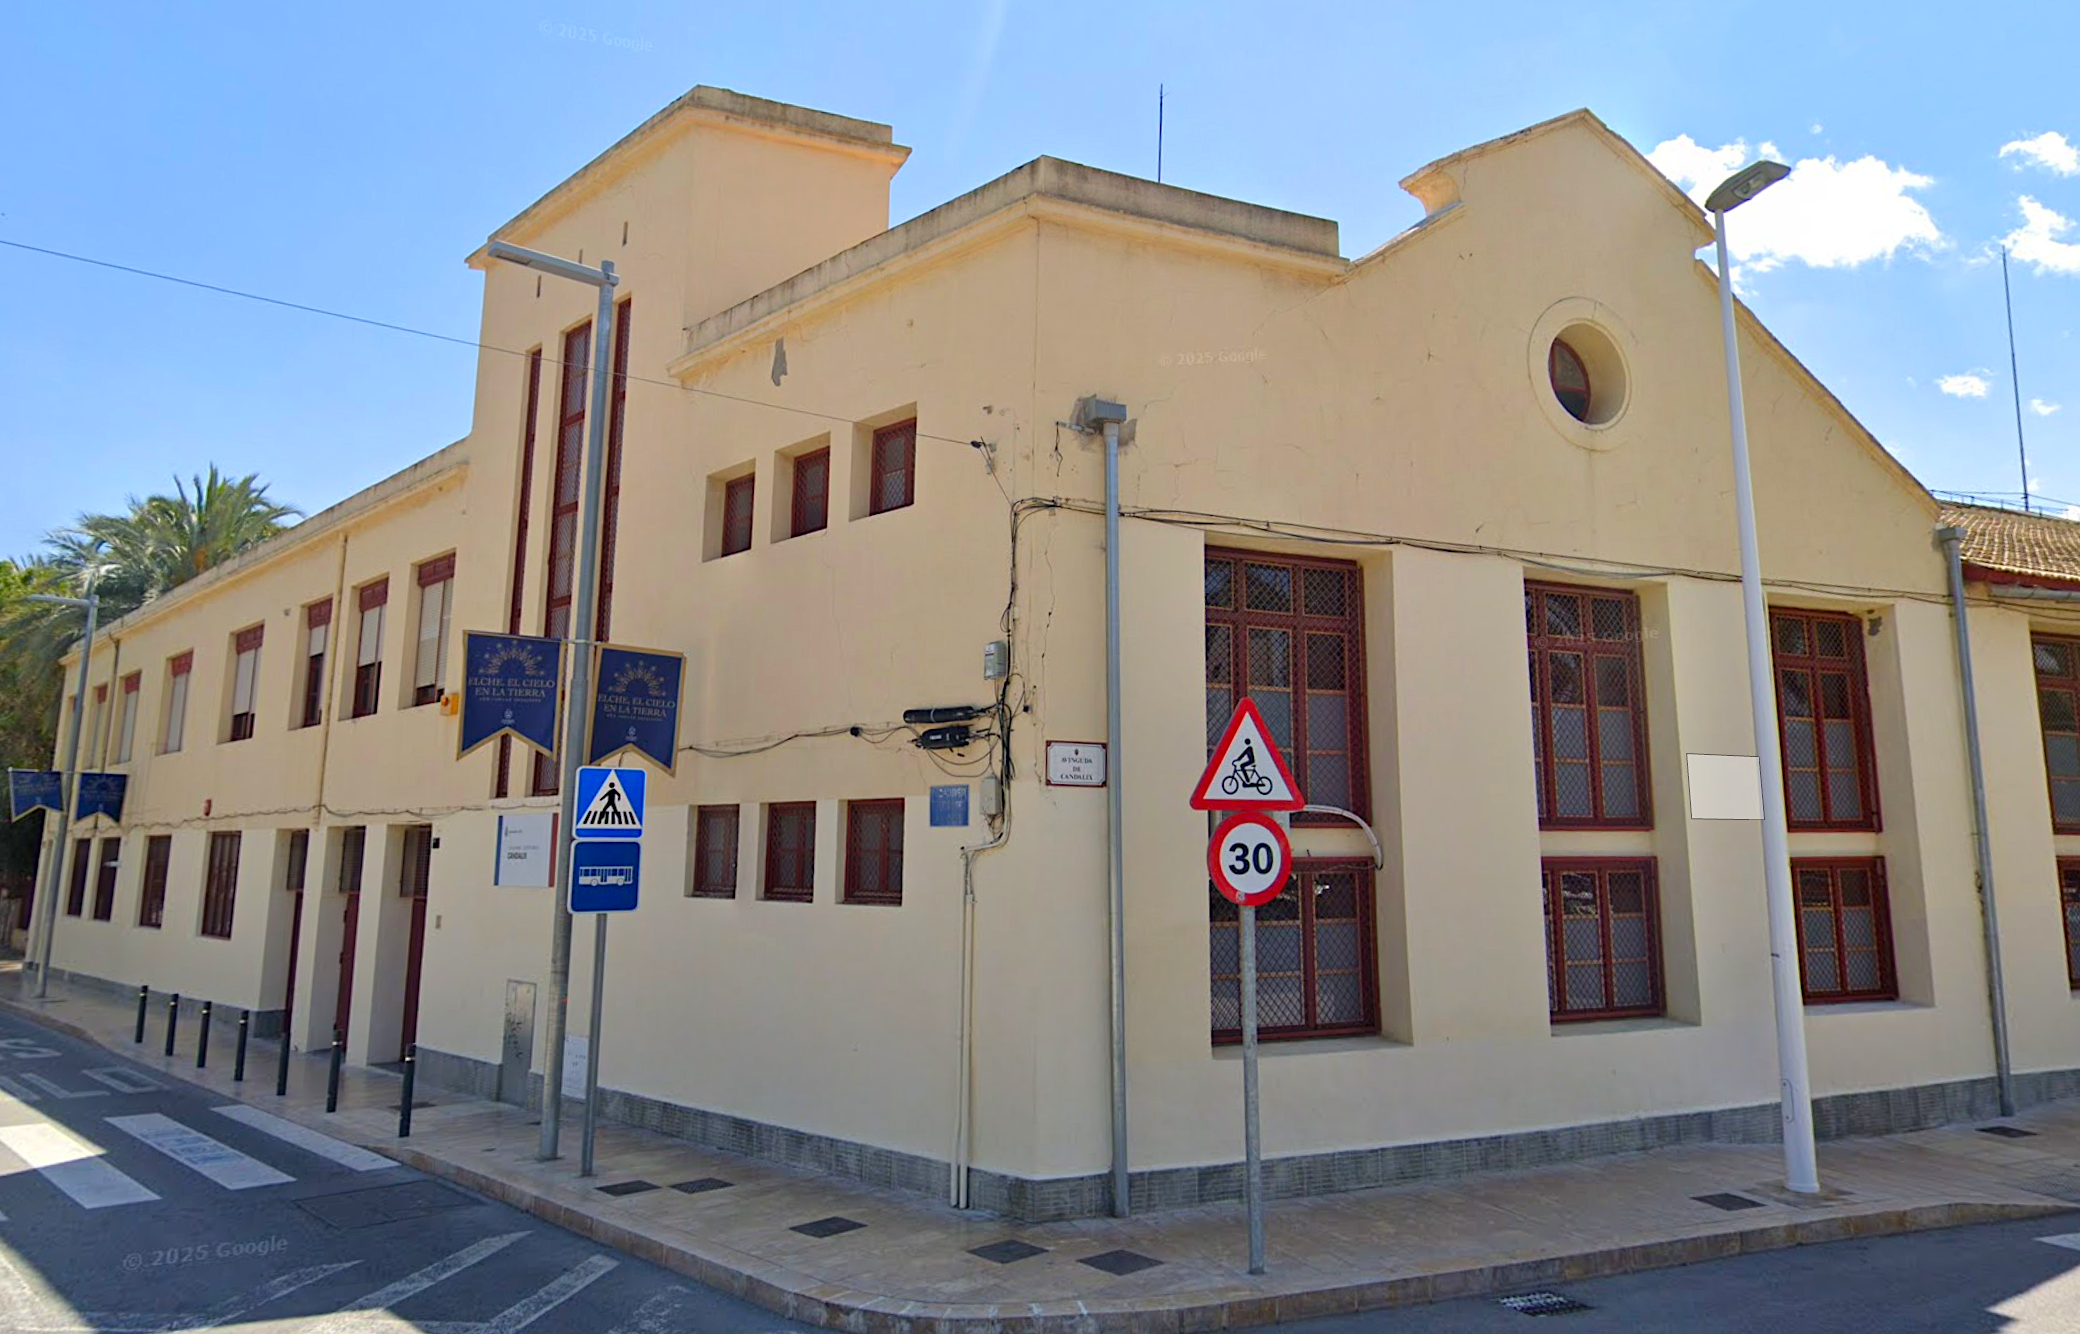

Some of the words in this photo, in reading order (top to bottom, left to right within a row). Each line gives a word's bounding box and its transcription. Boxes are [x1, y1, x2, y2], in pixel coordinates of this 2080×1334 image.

[507, 678, 520, 687] EL
[522, 678, 556, 688] CIELO
[475, 687, 489, 696] EN
[492, 687, 506, 697] LA
[508, 688, 546, 698] TIERRA
[632, 697, 644, 706] EL
[645, 698, 676, 708] CIELO
[603, 704, 616, 712] EN
[618, 705, 631, 714] LA
[633, 706, 667, 717] TIERRA
[1228, 843, 1274, 875] 30
